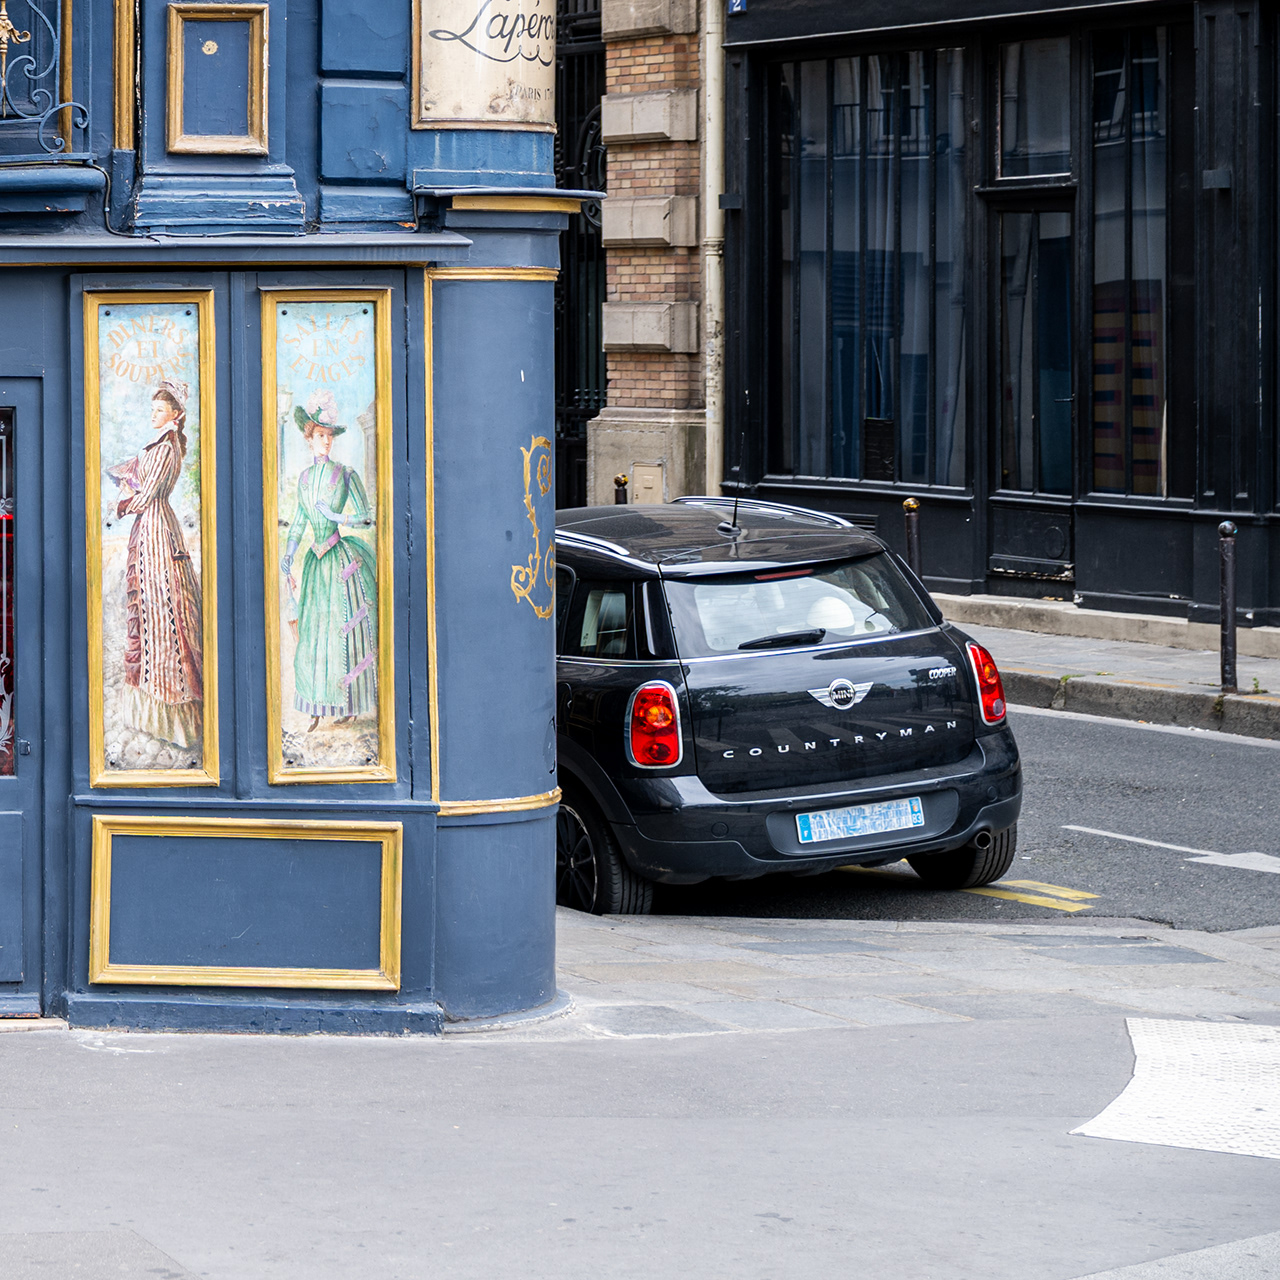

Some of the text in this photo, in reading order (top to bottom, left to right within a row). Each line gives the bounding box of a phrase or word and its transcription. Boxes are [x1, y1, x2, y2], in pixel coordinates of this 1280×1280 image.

[106, 314, 190, 348] DINERS
[283, 312, 365, 349] SALLES
[137, 340, 160, 358] ET
[312, 338, 340, 357] EN
[104, 346, 194, 385] SOUPERS
[289, 350, 366, 383] ETAGES
[928, 666, 957, 680] COOPER
[832, 689, 853, 700] MINI
[723, 721, 957, 759] COUNTRYMAN
[912, 812, 921, 824] 83
